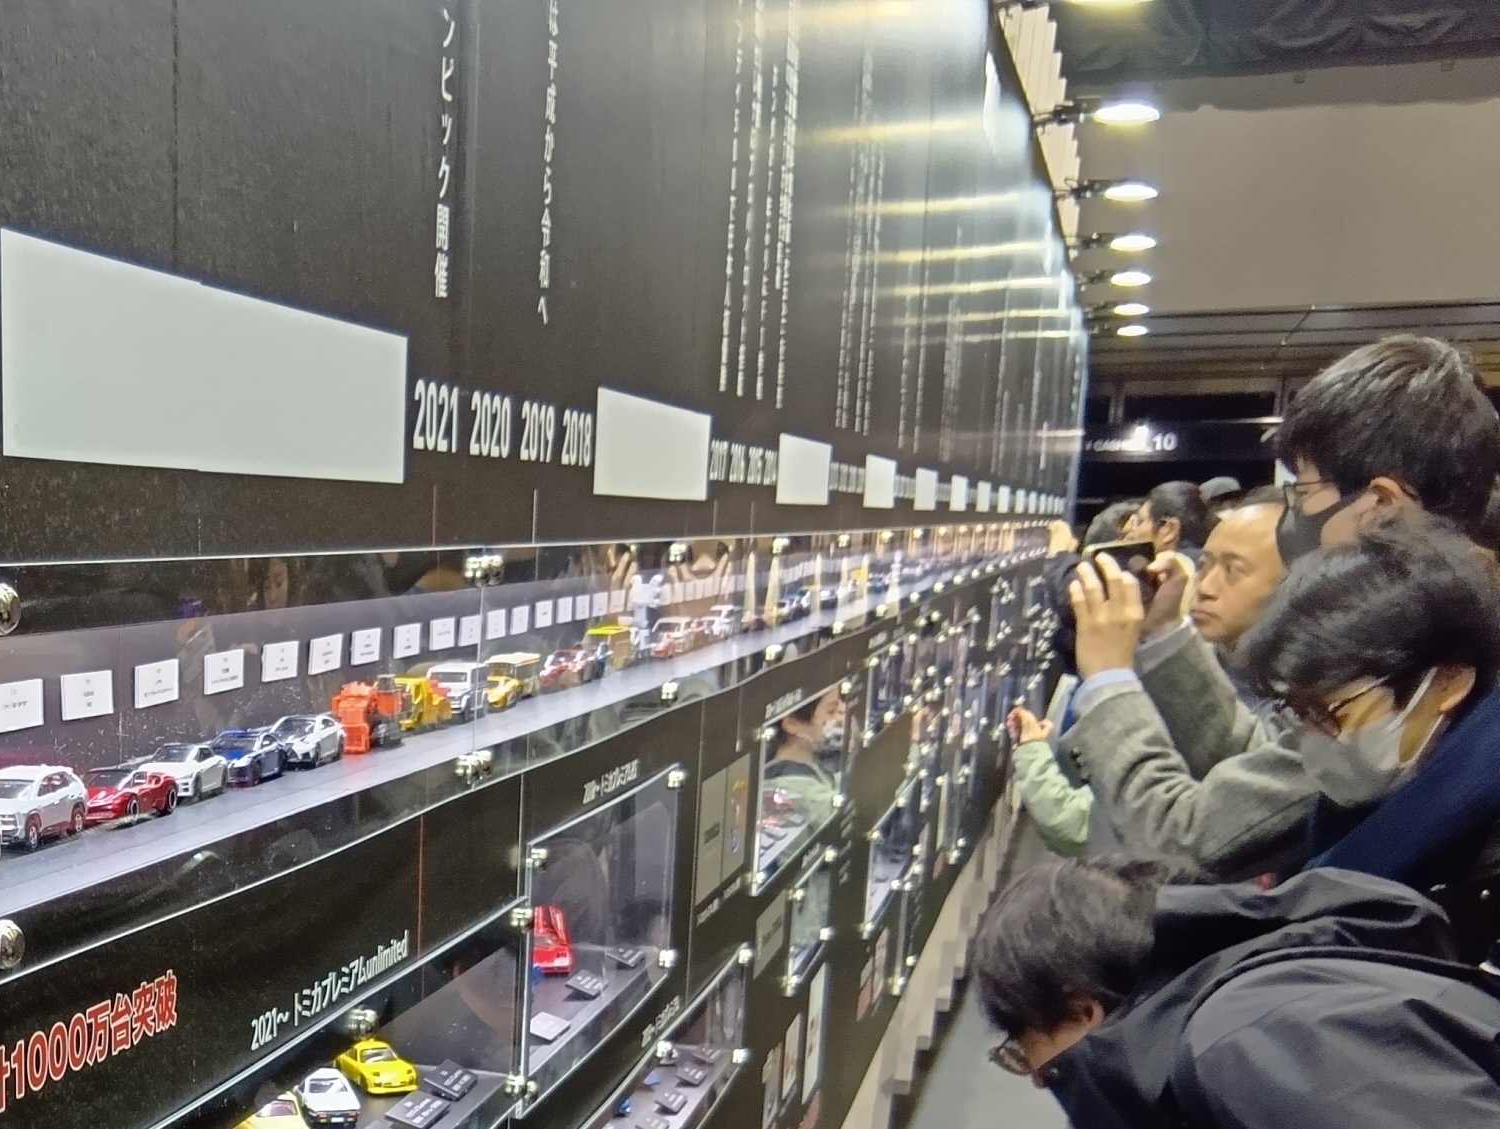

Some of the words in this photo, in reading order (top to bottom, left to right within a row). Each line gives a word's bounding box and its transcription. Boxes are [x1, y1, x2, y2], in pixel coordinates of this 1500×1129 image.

[413, 378, 459, 454] 2021
[469, 390, 512, 459] 2020
[520, 400, 555, 463] 2019
[561, 408, 592, 467] 2018
[294, 929, 410, 1027] トミカプレミアムunlimited
